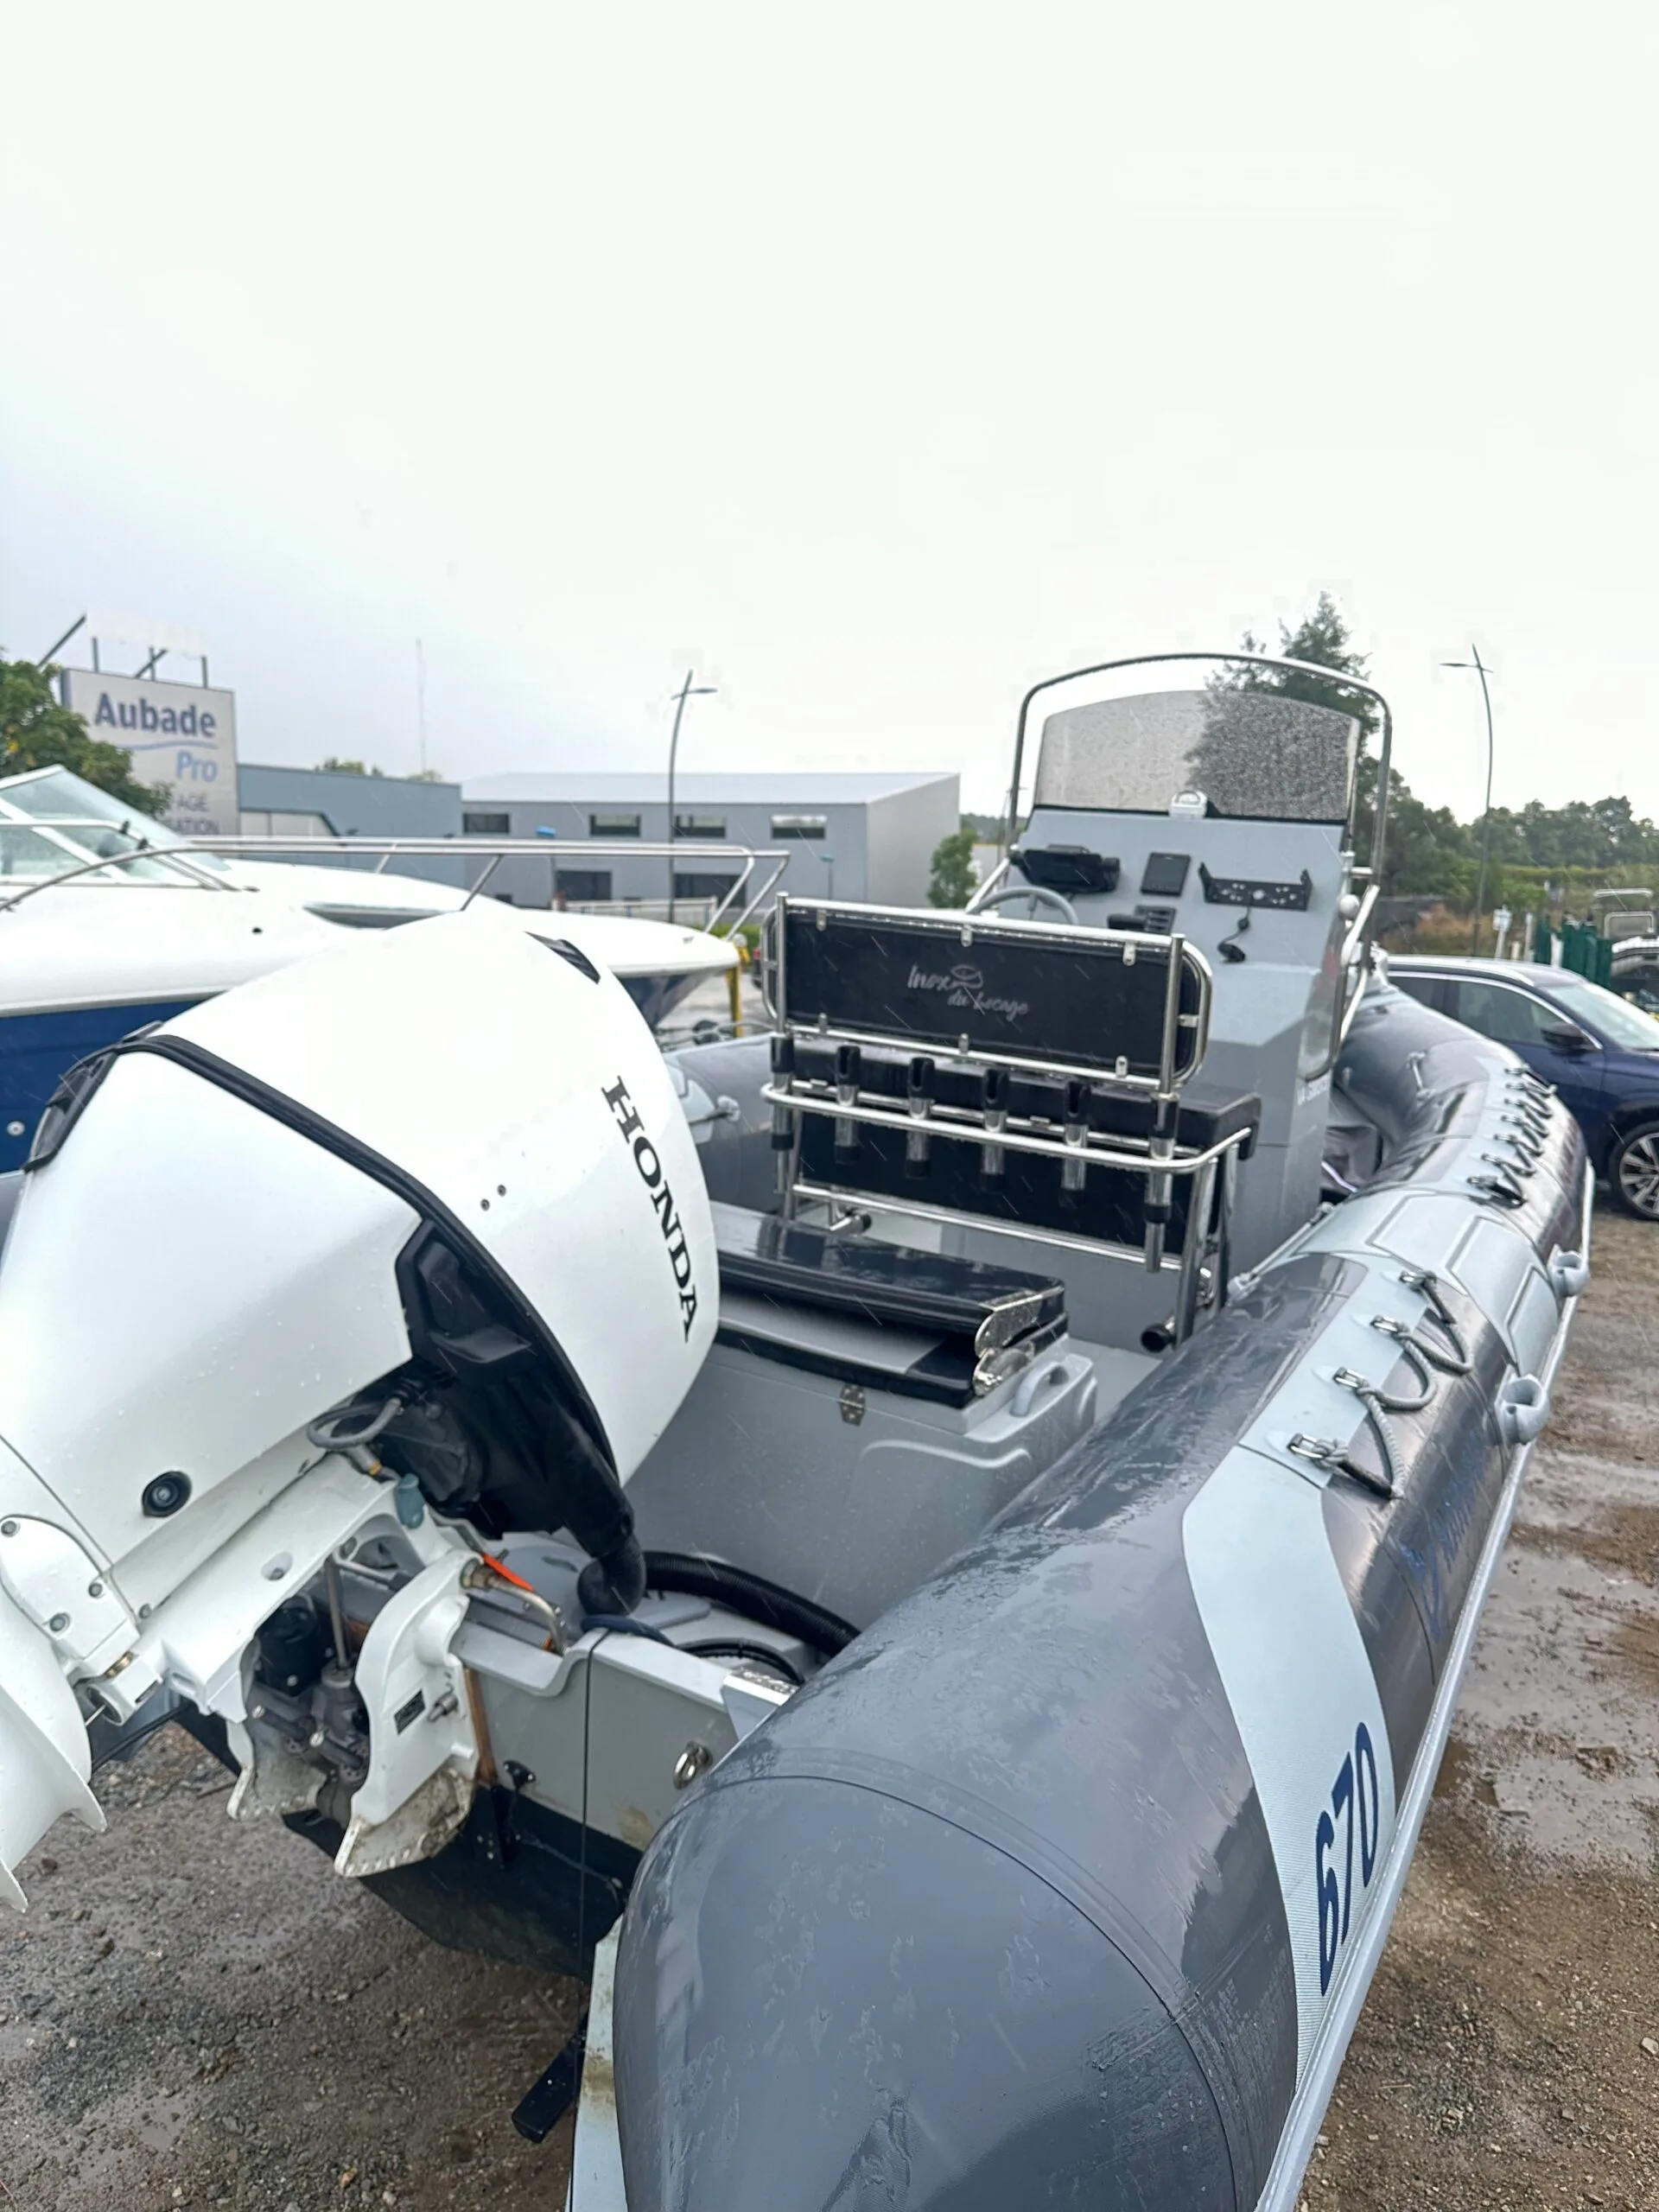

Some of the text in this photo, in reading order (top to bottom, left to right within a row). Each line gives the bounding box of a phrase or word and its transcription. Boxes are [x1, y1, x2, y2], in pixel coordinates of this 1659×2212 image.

[95, 692, 216, 738] Aubade
[176, 750, 218, 782] Pro
[601, 1075, 698, 1344] HONDA
[1315, 1721, 1379, 1997] 670
